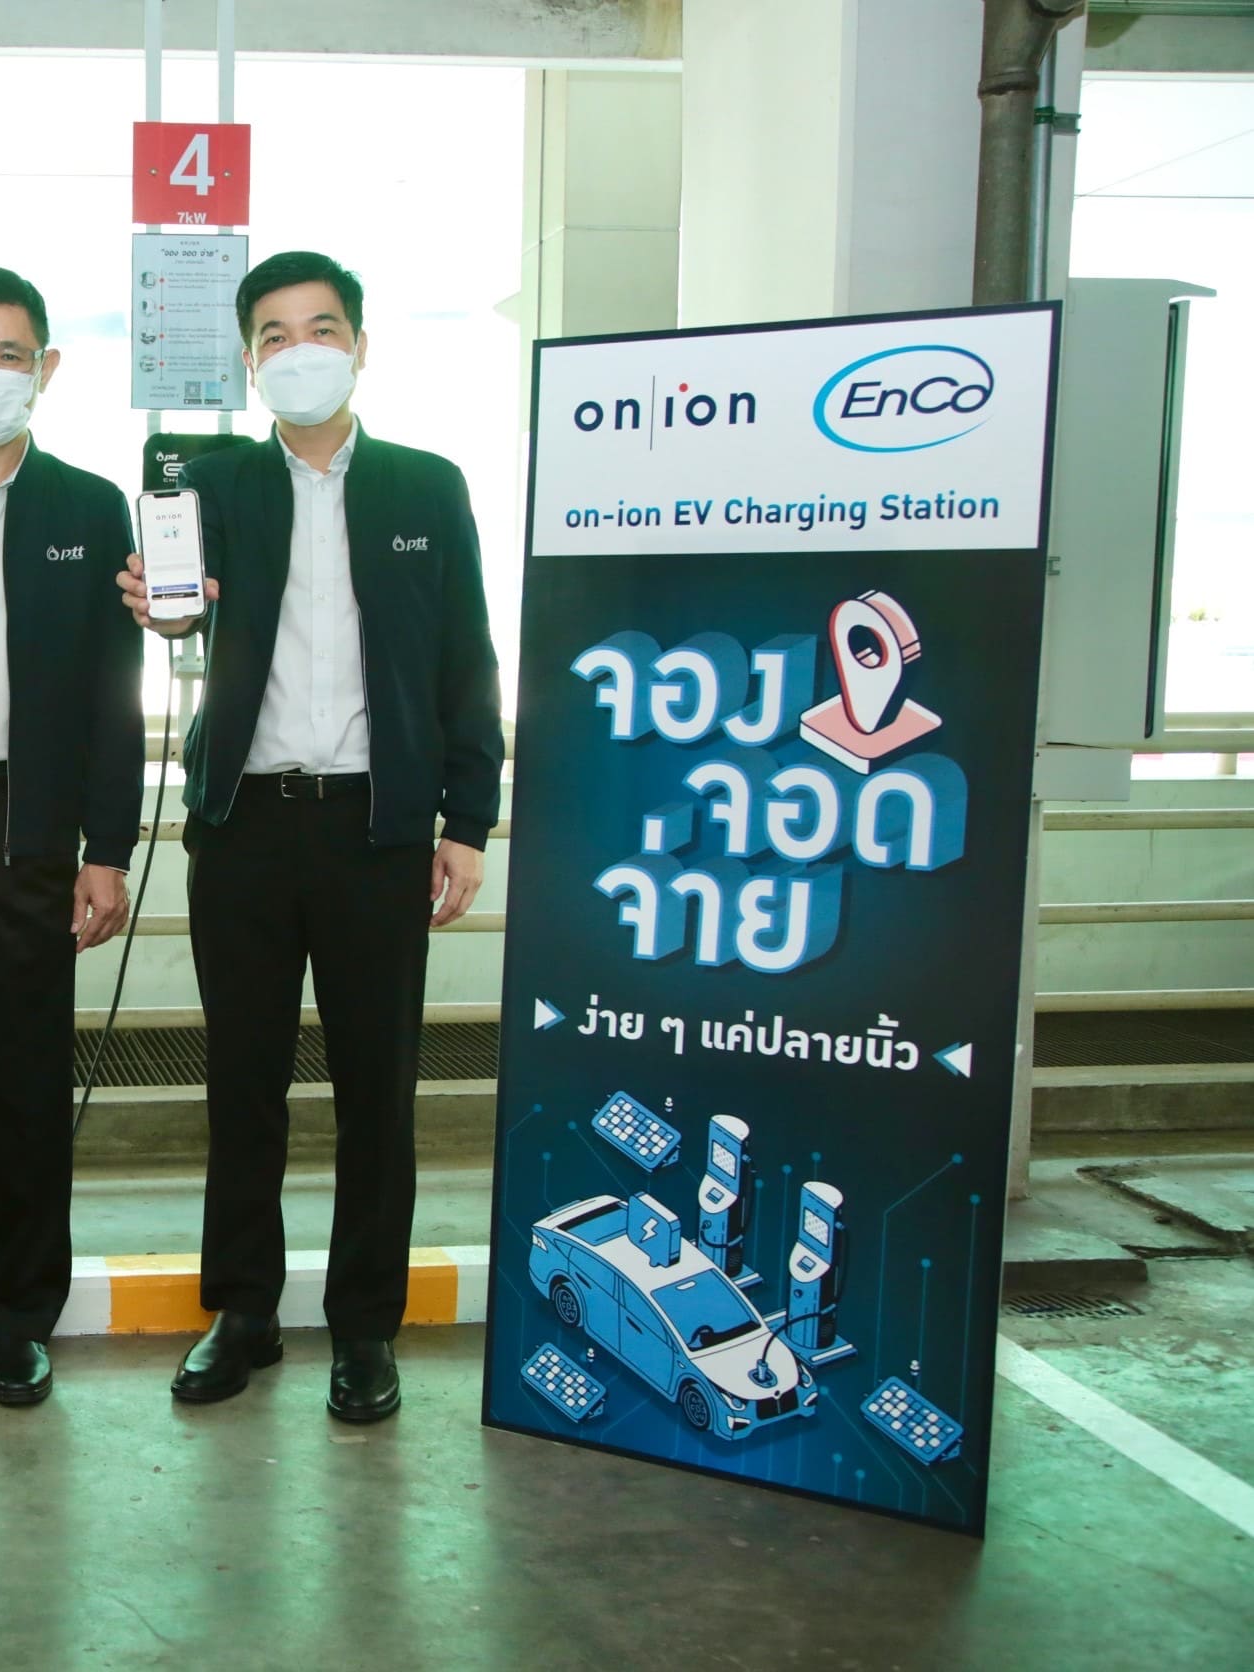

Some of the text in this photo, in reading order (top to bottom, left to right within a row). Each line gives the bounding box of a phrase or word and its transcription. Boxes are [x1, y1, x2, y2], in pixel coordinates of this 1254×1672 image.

[169, 133, 215, 196] 4
[177, 211, 207, 224] 7kW
[840, 376, 991, 419] EnCo
[565, 490, 1000, 531] on-ion EV Charging Station
[60, 545, 86, 560] ptt
[406, 536, 429, 551] ptt
[569, 643, 790, 746] จอง
[683, 759, 936, 872] จอด
[592, 814, 814, 974] จ่าย
[577, 994, 920, 1071] ง่าย ๆ แค่ปลายนิ้ว
